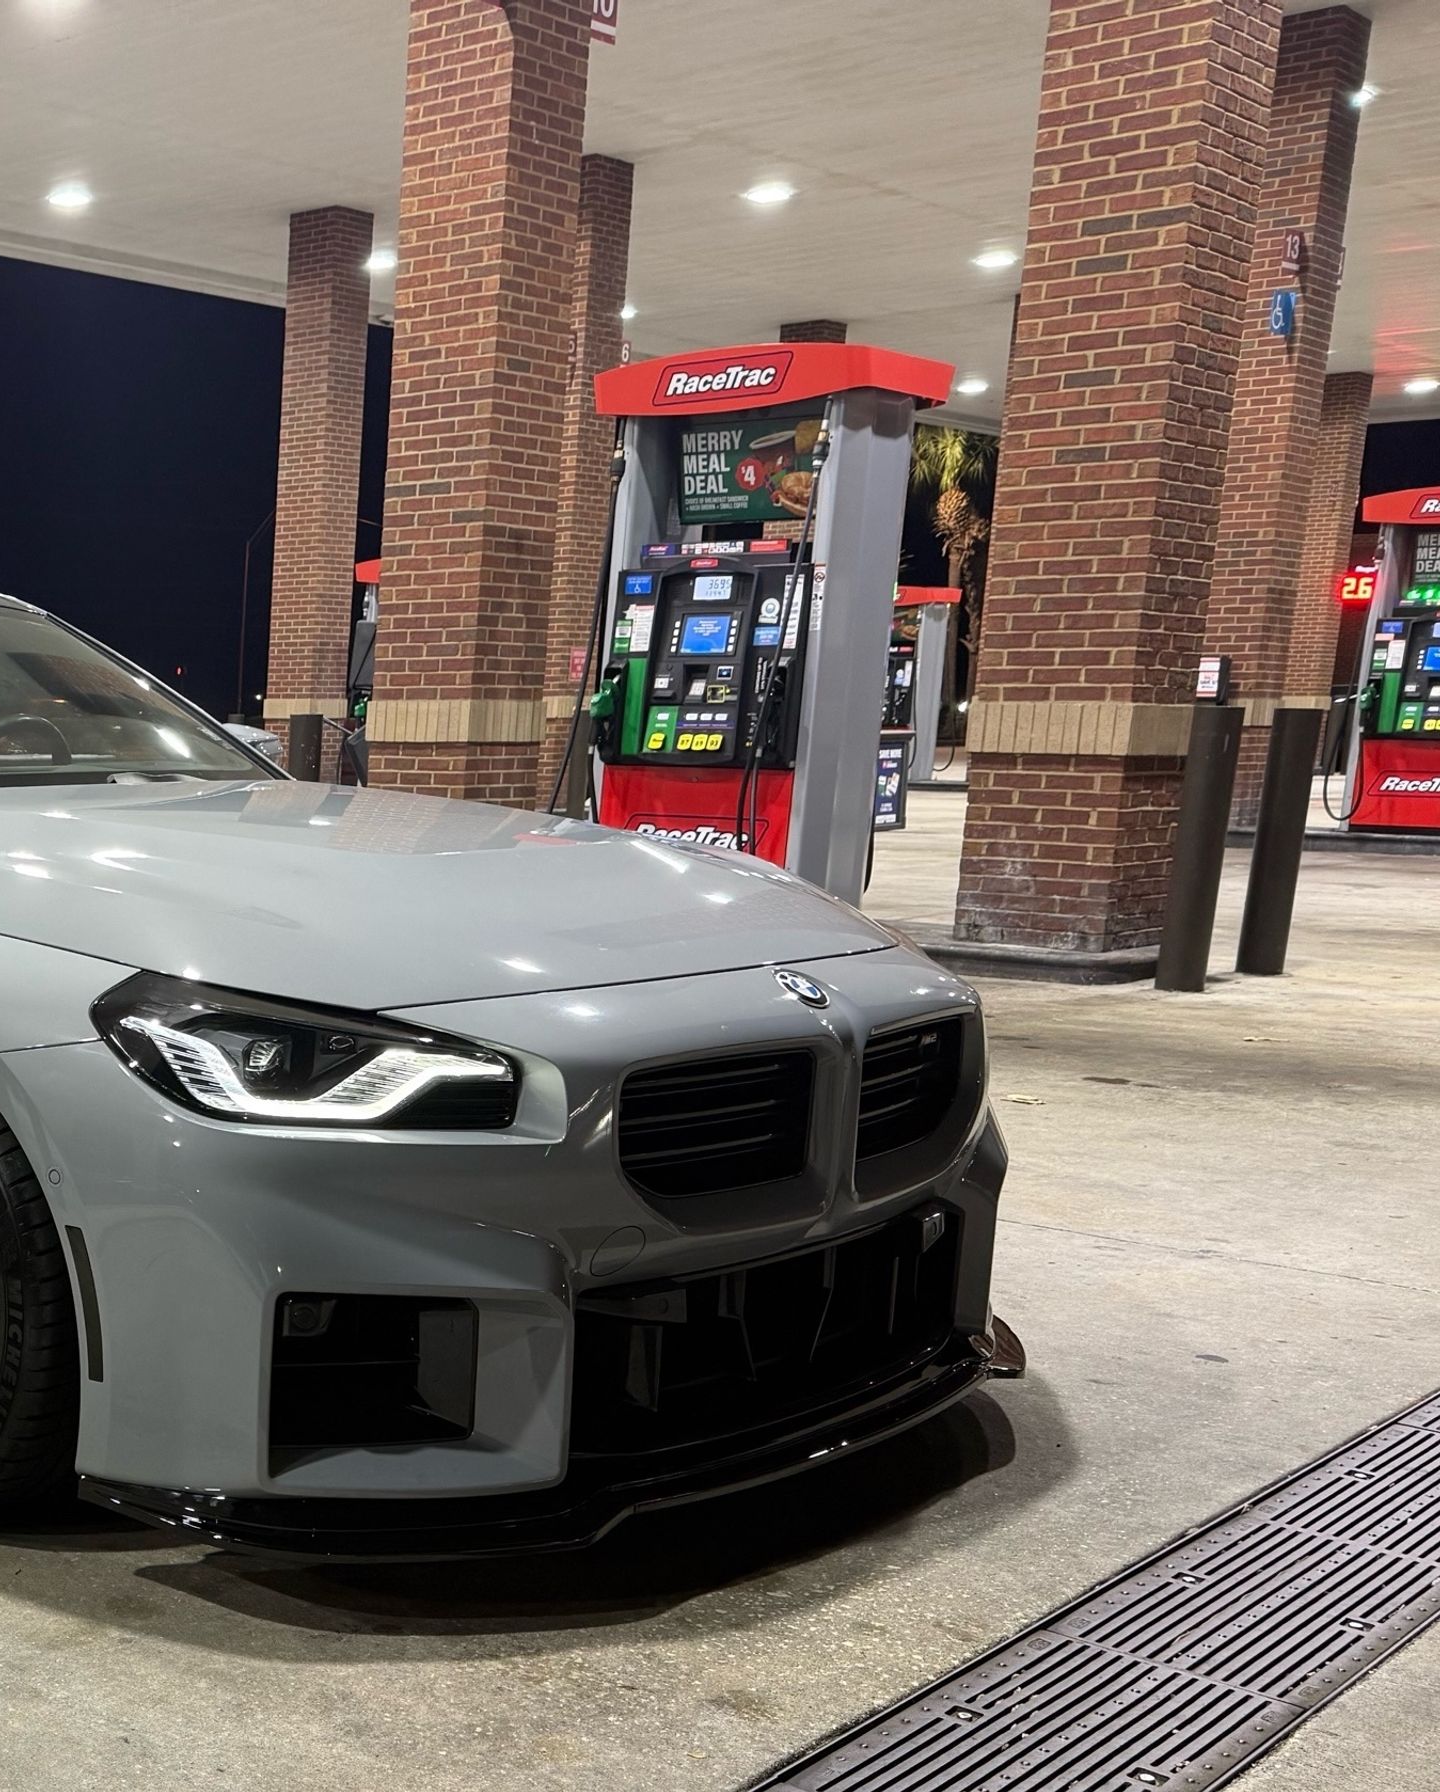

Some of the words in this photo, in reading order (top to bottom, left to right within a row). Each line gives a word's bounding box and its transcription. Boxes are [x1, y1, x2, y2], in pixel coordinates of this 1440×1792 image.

[1286, 234, 1301, 260] 13
[621, 343, 630, 363] 6
[665, 365, 777, 396] RaceTrac
[682, 430, 744, 453] MERRY
[683, 453, 731, 474] MEAL
[684, 474, 729, 495] DEAL
